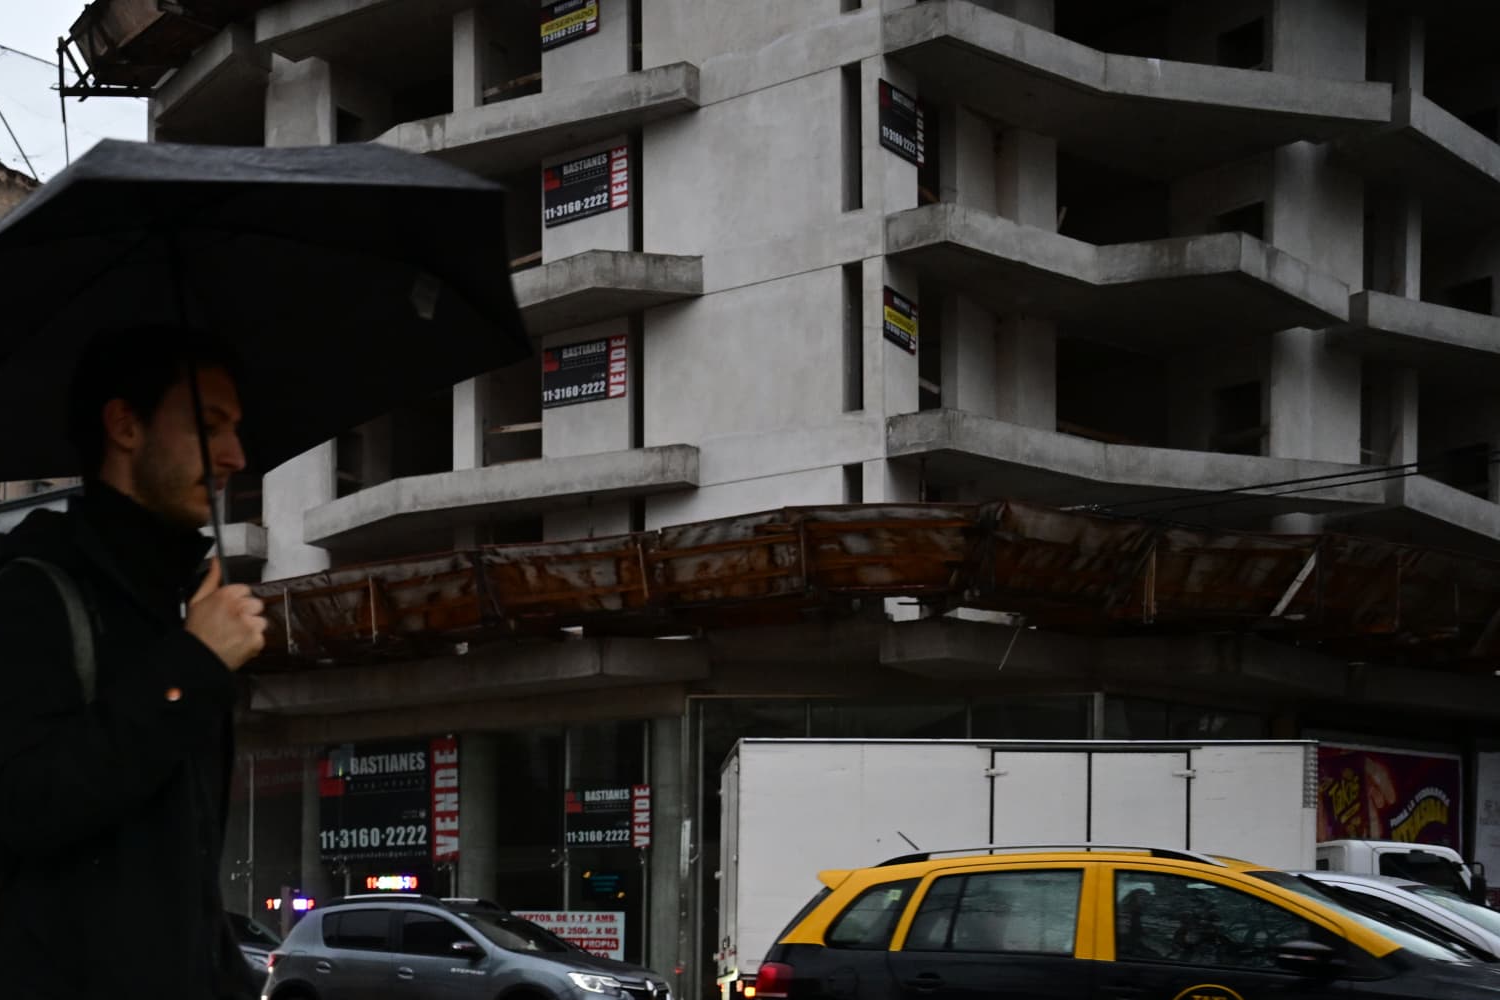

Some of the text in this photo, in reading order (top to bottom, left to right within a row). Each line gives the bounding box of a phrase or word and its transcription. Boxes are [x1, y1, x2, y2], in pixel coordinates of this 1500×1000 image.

[563, 153, 608, 175] BASTIANES
[611, 147, 628, 208] VENDE
[610, 337, 627, 398] VENDE
[350, 751, 426, 775] BASTIANES
[434, 748, 459, 856] VENDE
[584, 788, 630, 801] BASTIANES
[633, 786, 650, 847] VENDE
